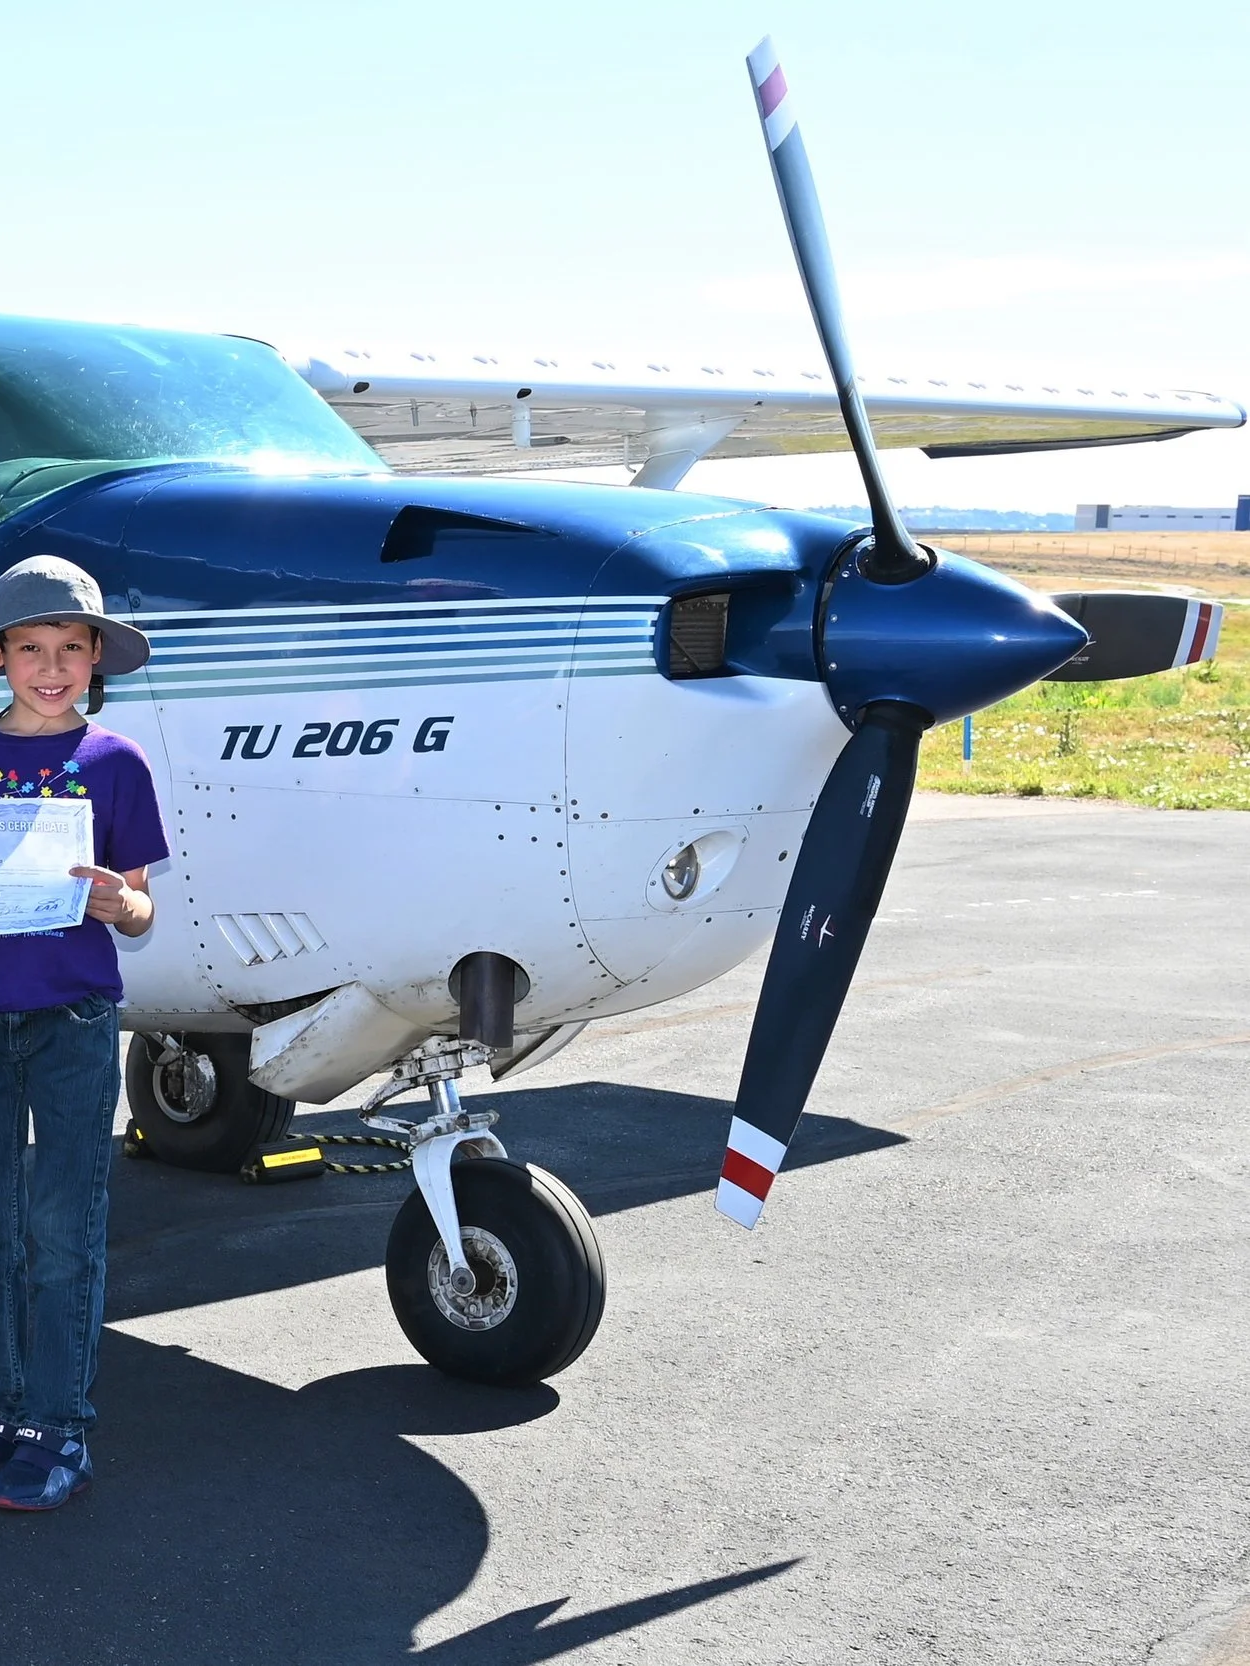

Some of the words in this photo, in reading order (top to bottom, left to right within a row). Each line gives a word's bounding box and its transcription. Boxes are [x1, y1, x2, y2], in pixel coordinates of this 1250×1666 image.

[220, 724, 282, 760] TU
[292, 718, 400, 758] 206
[412, 716, 455, 753] G
[8, 821, 69, 833] CERTIFICATE
[15, 1427, 43, 1441] ND1
